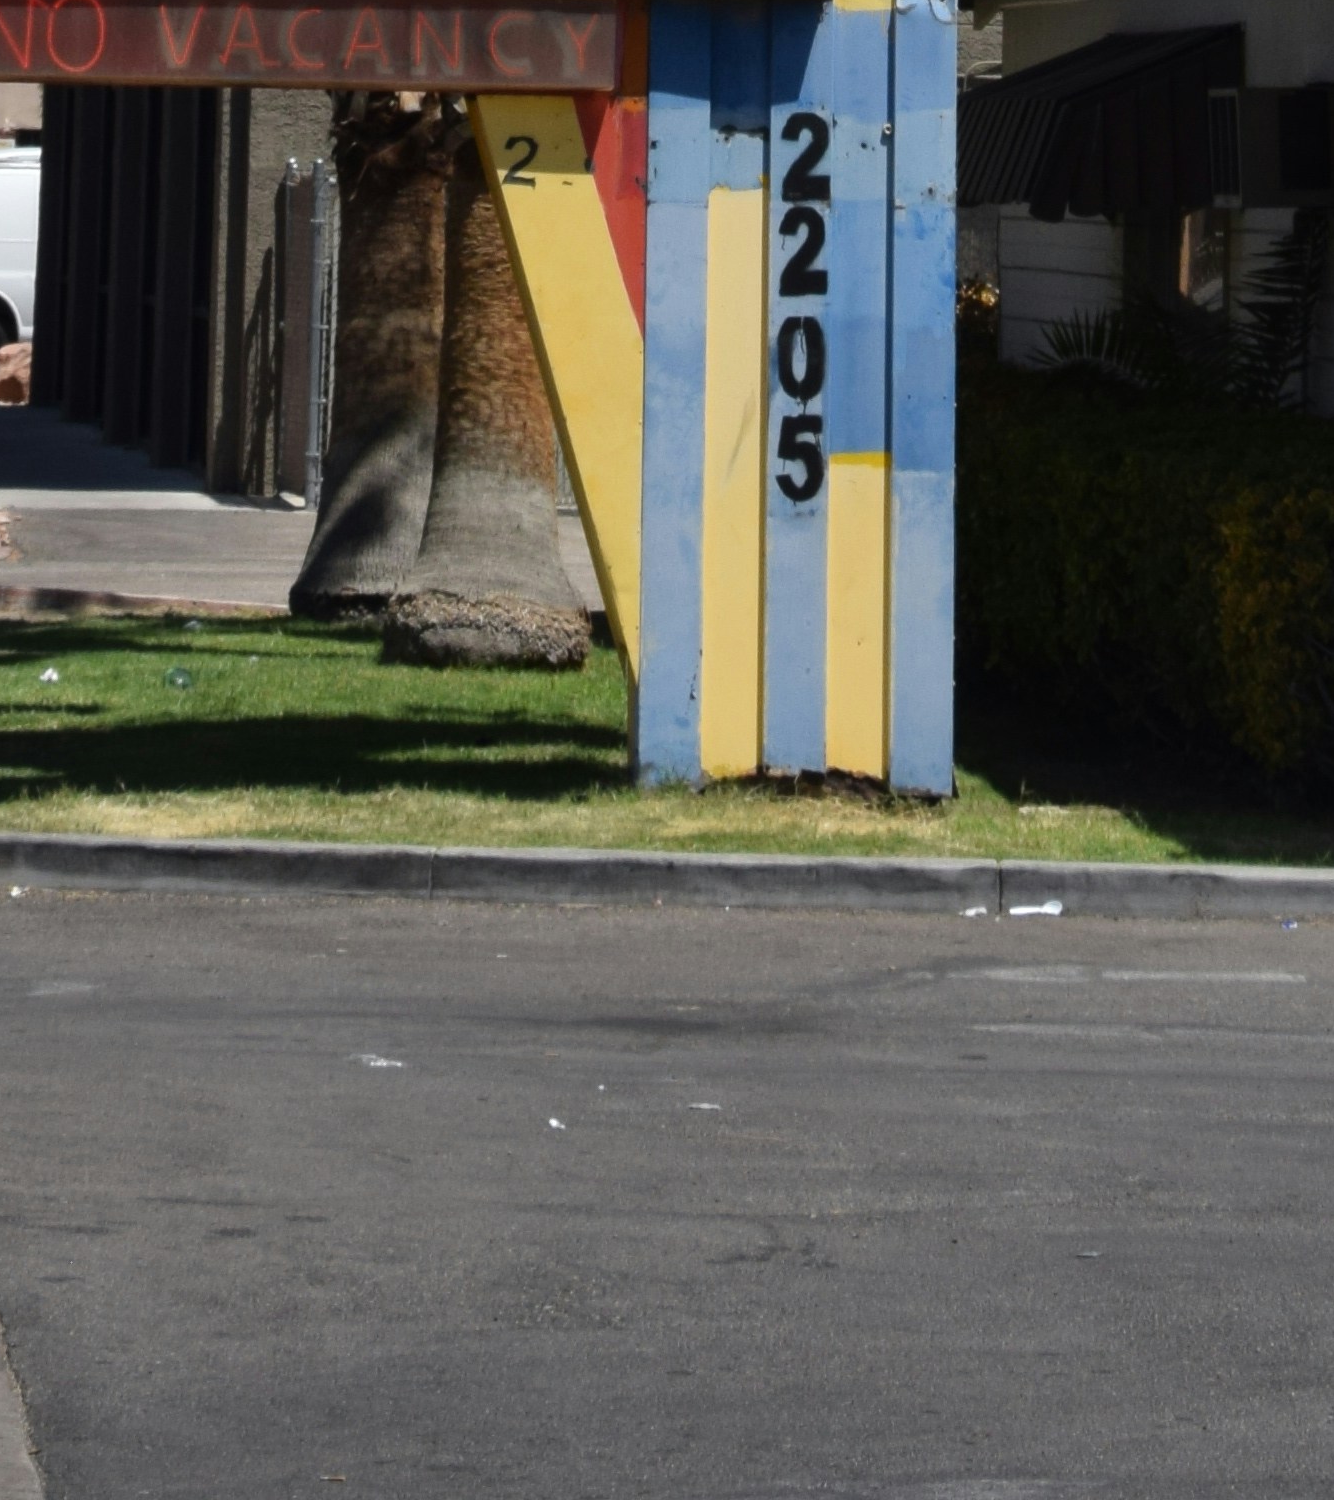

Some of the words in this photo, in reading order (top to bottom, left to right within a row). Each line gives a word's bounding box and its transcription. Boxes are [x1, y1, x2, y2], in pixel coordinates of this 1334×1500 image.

[157, 0, 602, 78] VACANCY
[502, 134, 540, 189] 2
[774, 110, 832, 503] 2205
